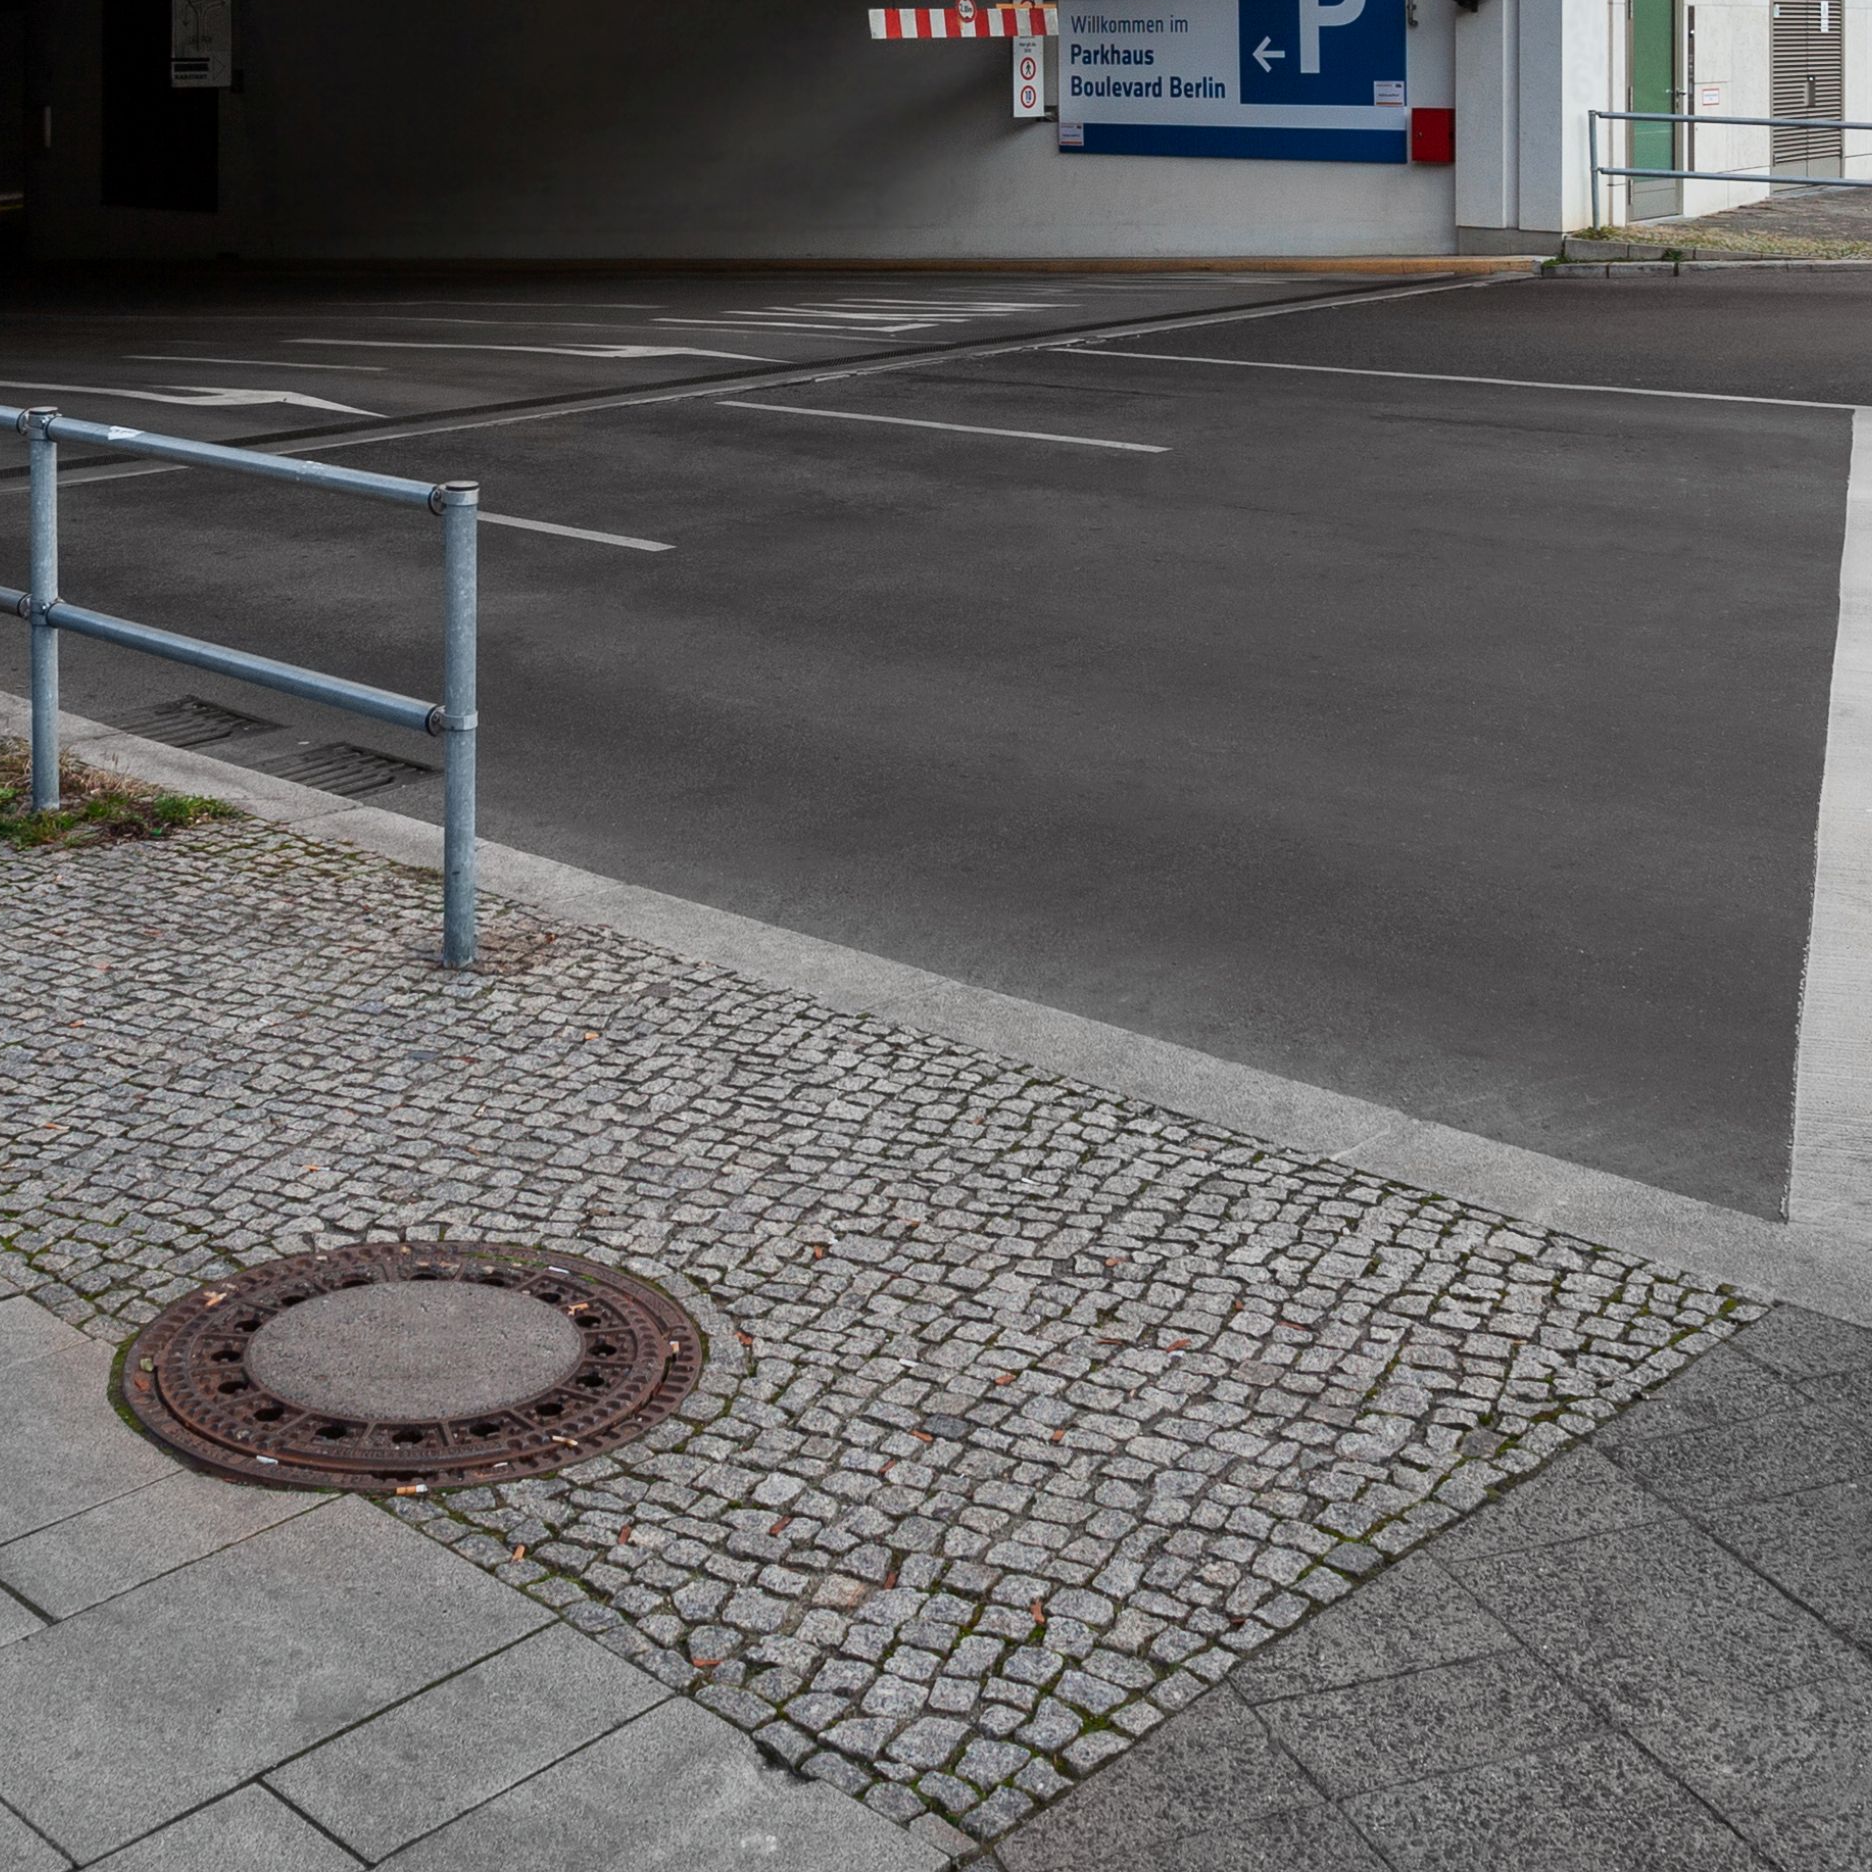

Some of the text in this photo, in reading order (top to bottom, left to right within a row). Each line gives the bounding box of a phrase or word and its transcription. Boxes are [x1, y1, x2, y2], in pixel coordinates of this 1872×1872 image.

[1071, 15, 1188, 33] Willkommen im
[1071, 44, 1154, 65] Parkhaus
[1071, 75, 1226, 98] Boulevard Berlin
